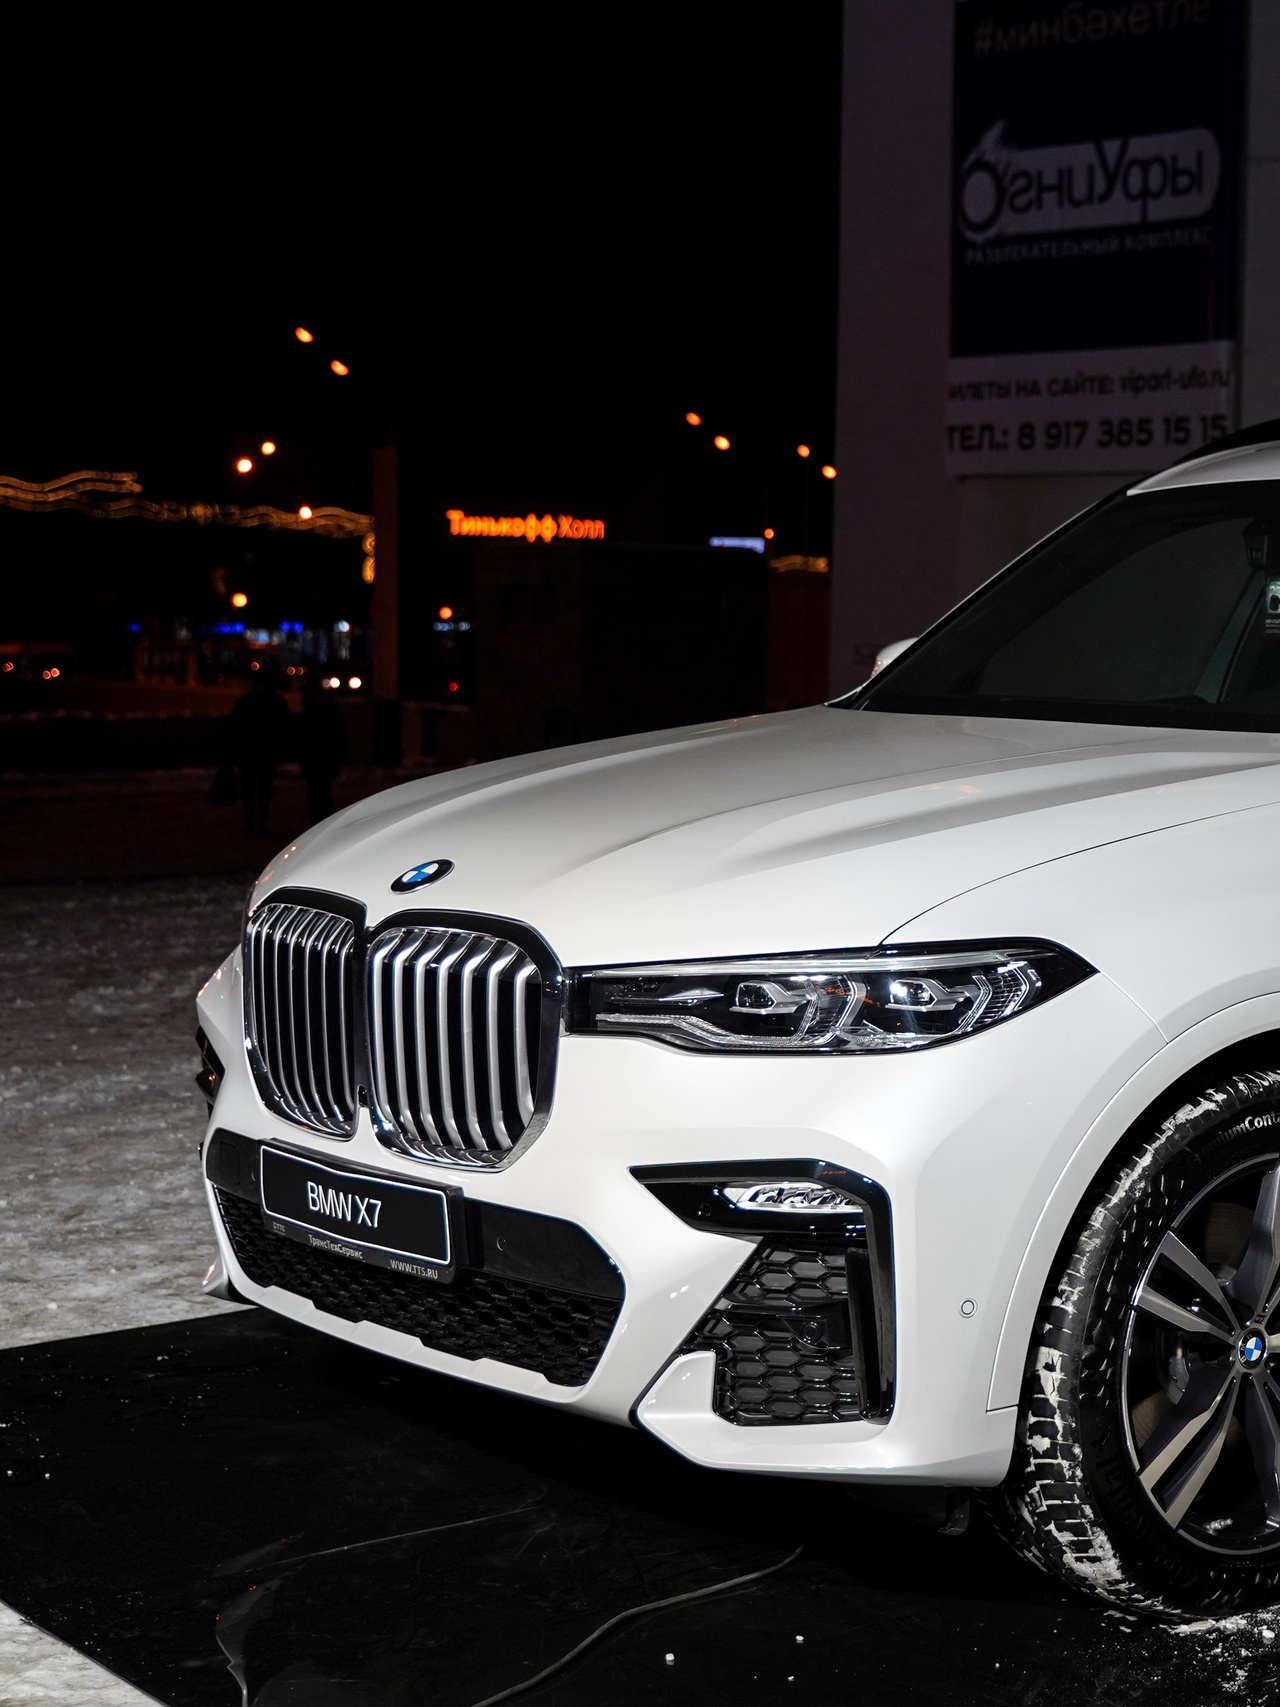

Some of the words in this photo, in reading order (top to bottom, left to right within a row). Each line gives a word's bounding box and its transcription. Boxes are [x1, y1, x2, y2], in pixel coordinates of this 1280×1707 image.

[965, 233, 1120, 267] РАЗВЛЕКАТЕЛЬНЫЙ
[1015, 378, 1042, 397] НА
[1047, 372, 1115, 397] САЙТЕ:
[1018, 421, 1036, 451] 8
[1045, 419, 1088, 450] 917
[1098, 416, 1153, 447] 385
[1164, 415, 1191, 446] 15
[1200, 413, 1227, 442] 15
[446, 509, 558, 543] Тинькофф
[557, 514, 605, 540] Холл
[305, 1180, 353, 1222] BMW
[354, 1194, 383, 1230] X7
[308, 1233, 364, 1260] ТрансТехСервис
[389, 1258, 439, 1280] WWW.TTS.RU
